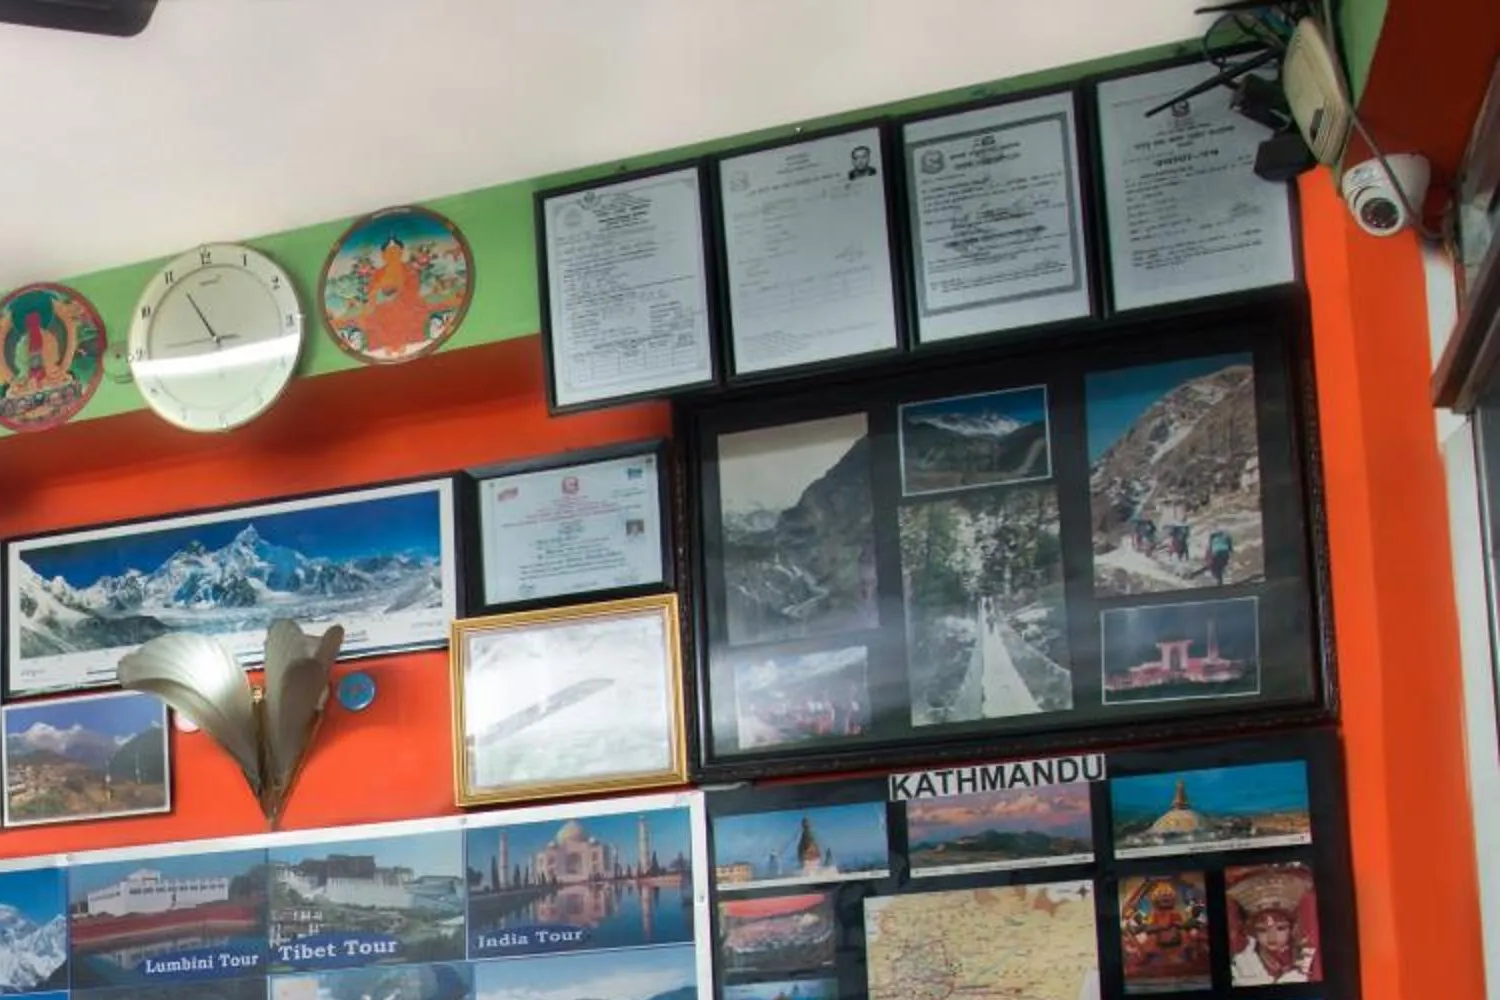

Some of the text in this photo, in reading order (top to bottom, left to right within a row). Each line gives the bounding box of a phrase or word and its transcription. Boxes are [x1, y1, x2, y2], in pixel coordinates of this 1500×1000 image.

[891, 755, 1102, 800] KATHMANDU
[278, 938, 398, 962] Tibet Tour
[477, 929, 583, 949] India Tour
[145, 952, 260, 973] Lumbini Tour
